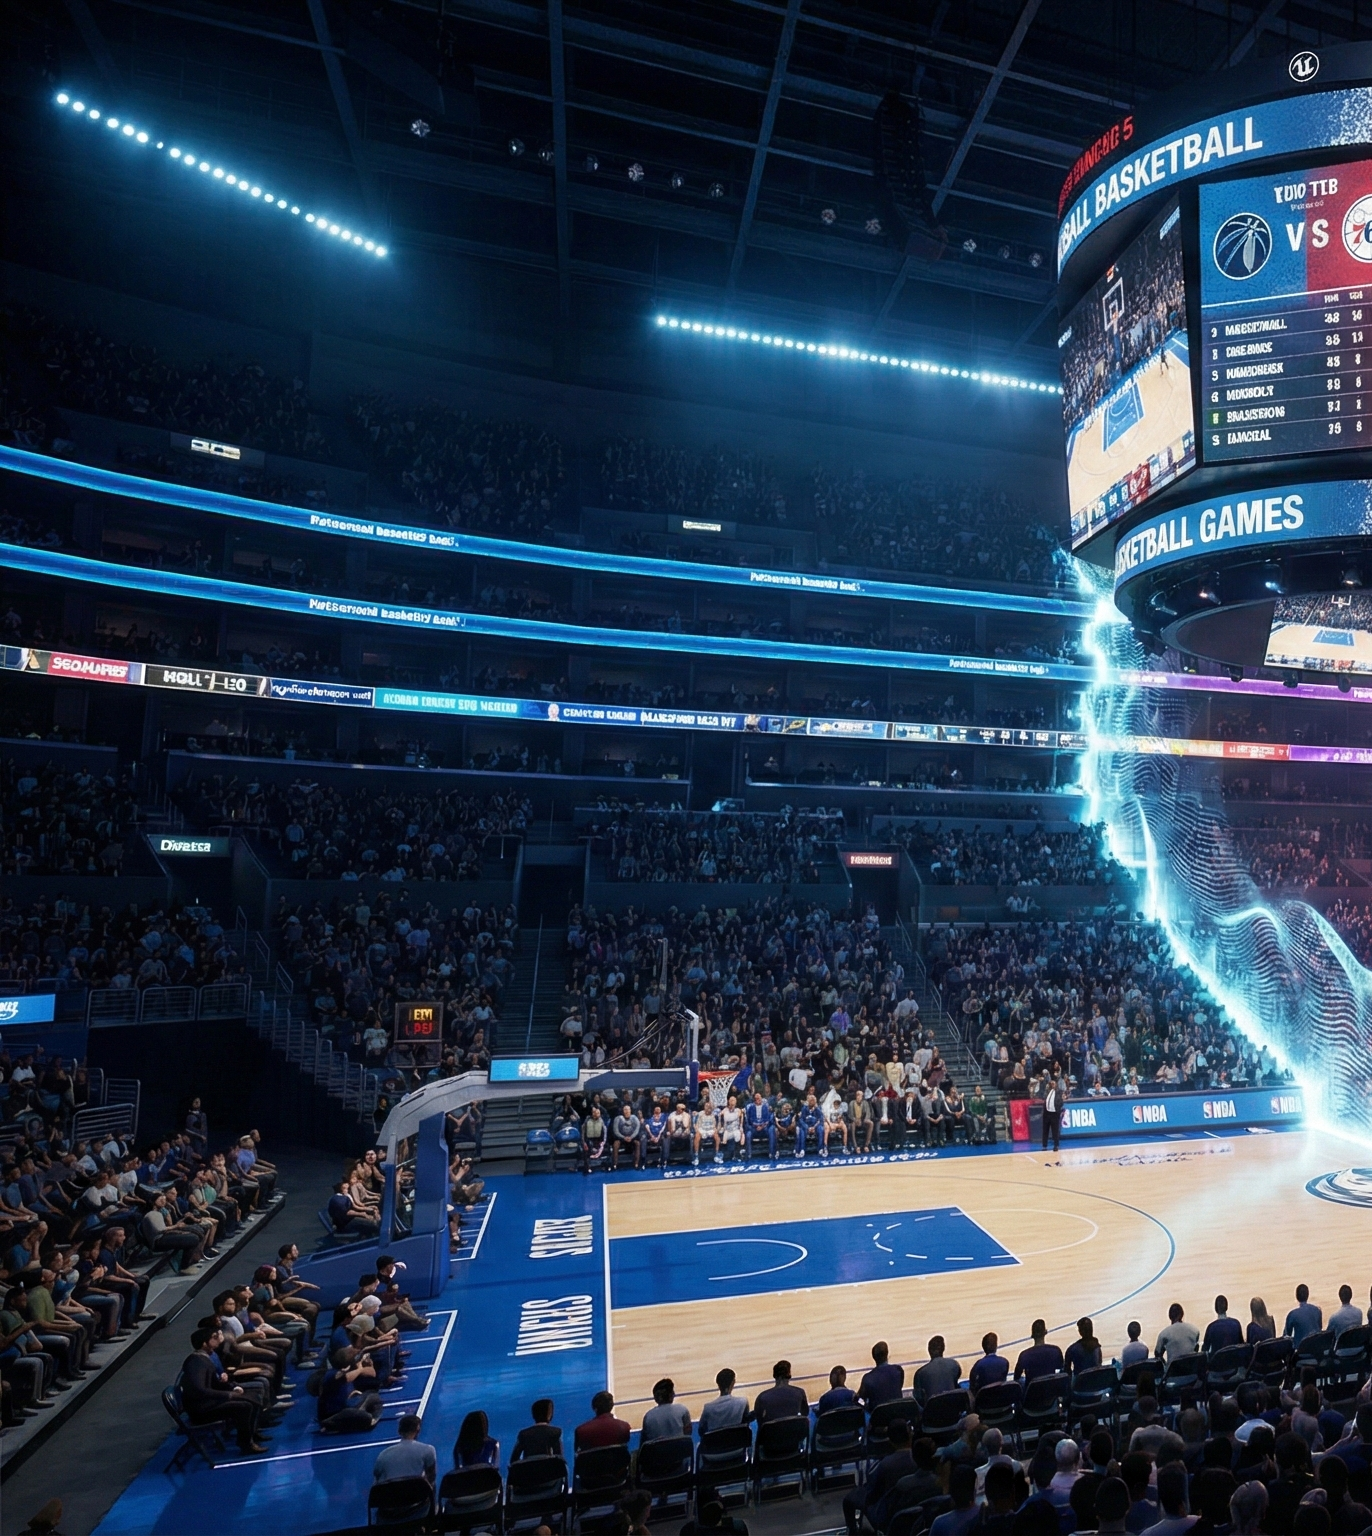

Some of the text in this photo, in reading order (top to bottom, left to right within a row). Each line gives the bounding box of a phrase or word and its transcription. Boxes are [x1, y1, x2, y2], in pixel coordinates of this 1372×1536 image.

[1094, 117, 1263, 218] BASKETBALL
[1200, 494, 1304, 543] GAMES
[1072, 1108, 1096, 1127] NBA
